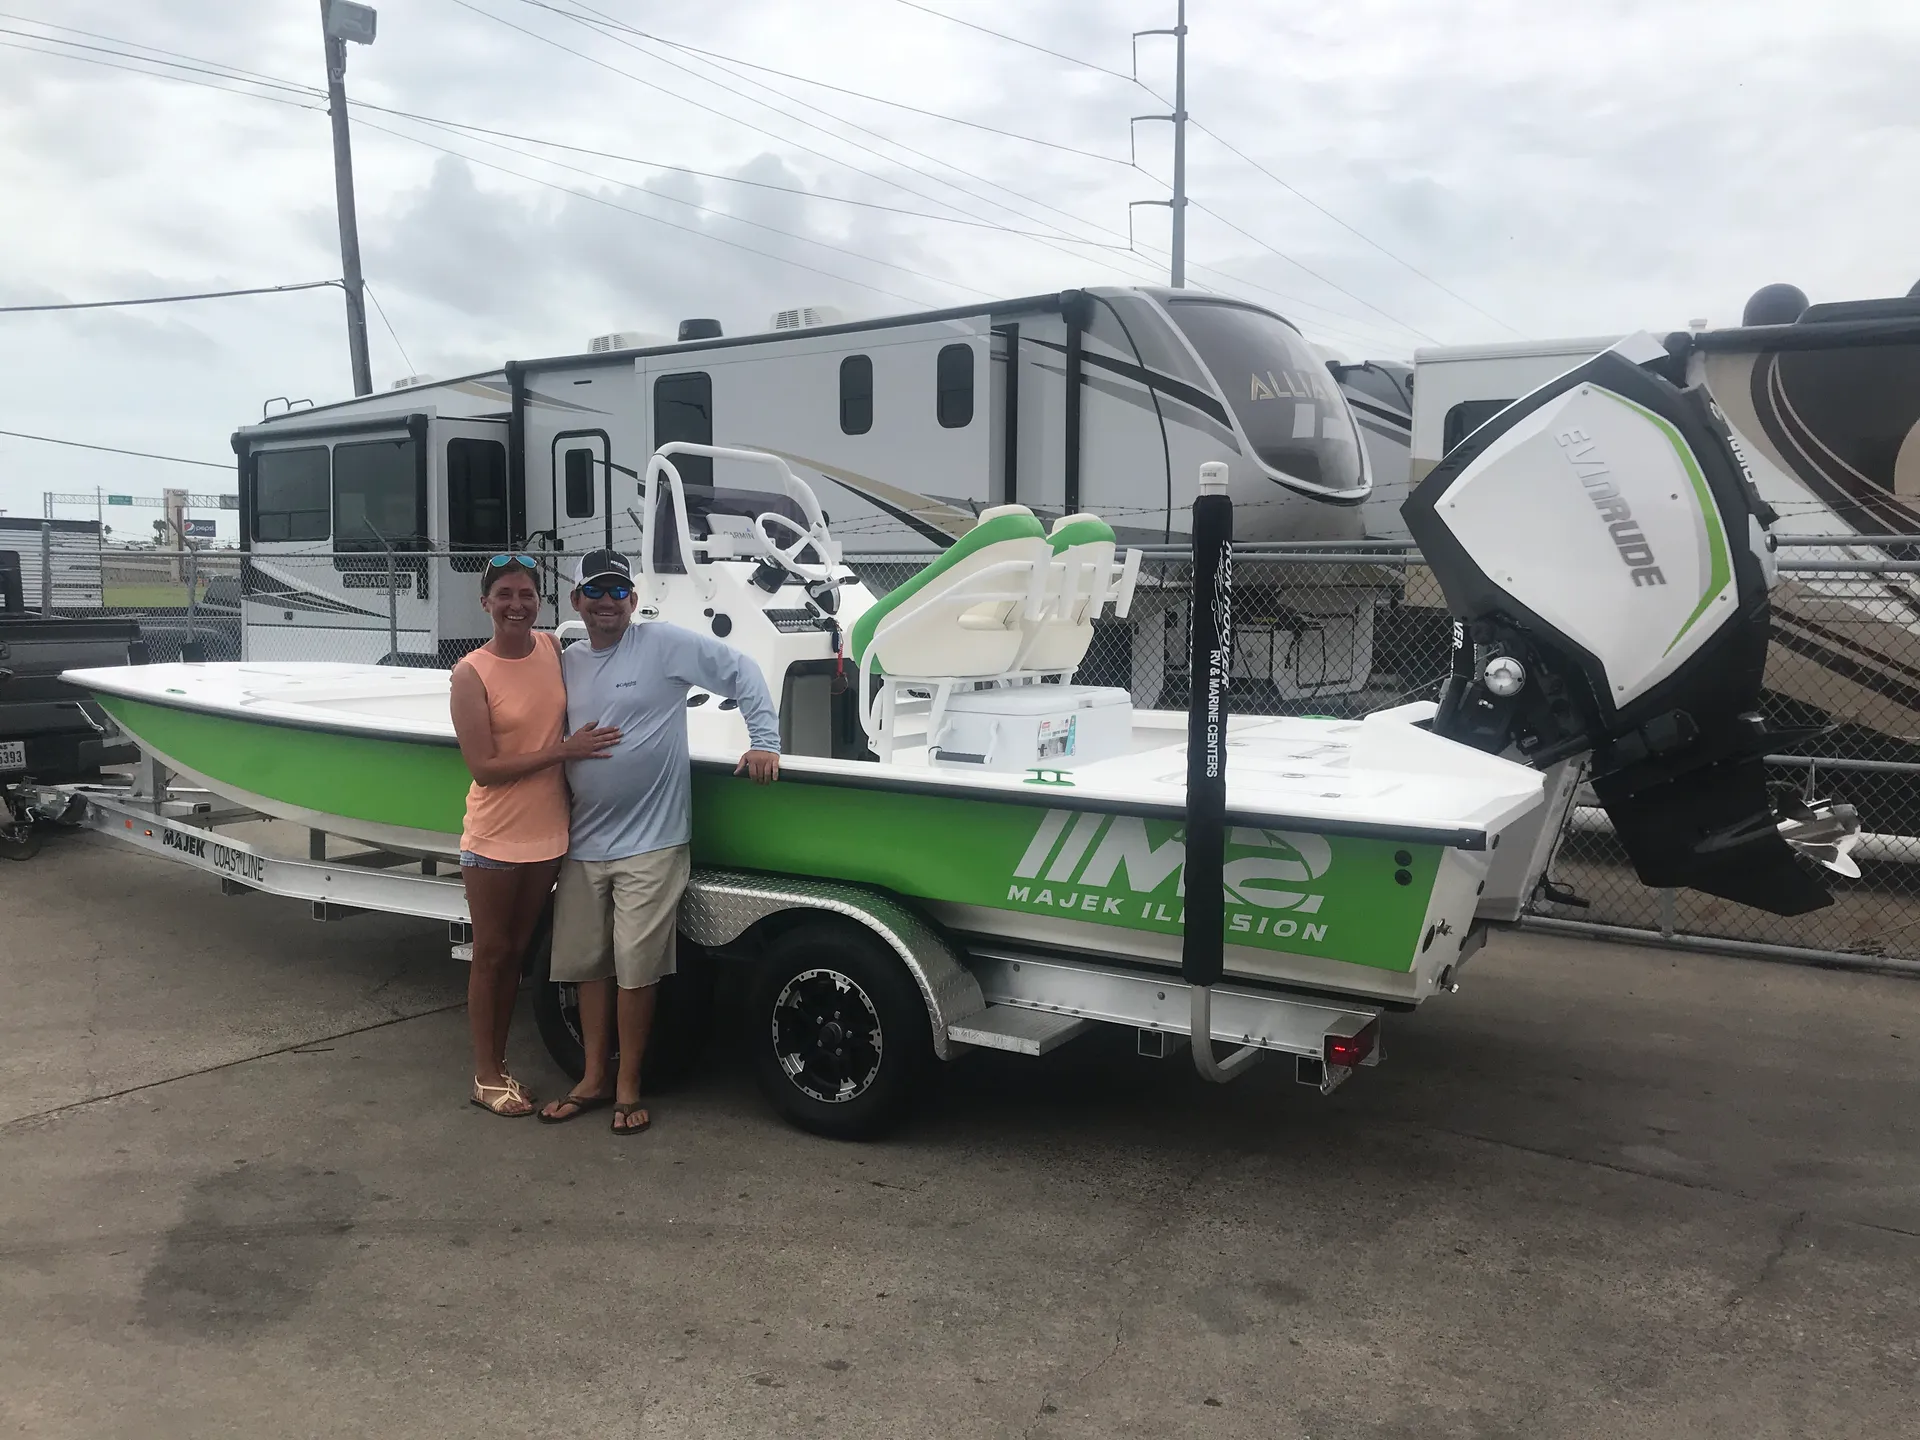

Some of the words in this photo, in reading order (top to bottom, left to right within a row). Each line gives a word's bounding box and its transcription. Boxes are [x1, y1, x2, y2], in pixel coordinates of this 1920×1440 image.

[195, 524, 215, 532] pepsi
[1554, 430, 1667, 587] EVINRUDE
[1210, 649, 1221, 667] RV
[1221, 594, 1232, 689] HOOVER
[1209, 667, 1220, 676] &
[1207, 678, 1220, 723] MARINE
[1206, 724, 1219, 778] CENTERS
[163, 828, 206, 859] MAJEK
[213, 843, 265, 882] COASTLINE
[1006, 885, 1125, 915] MAJEK
[1141, 902, 1328, 942] ILSION
